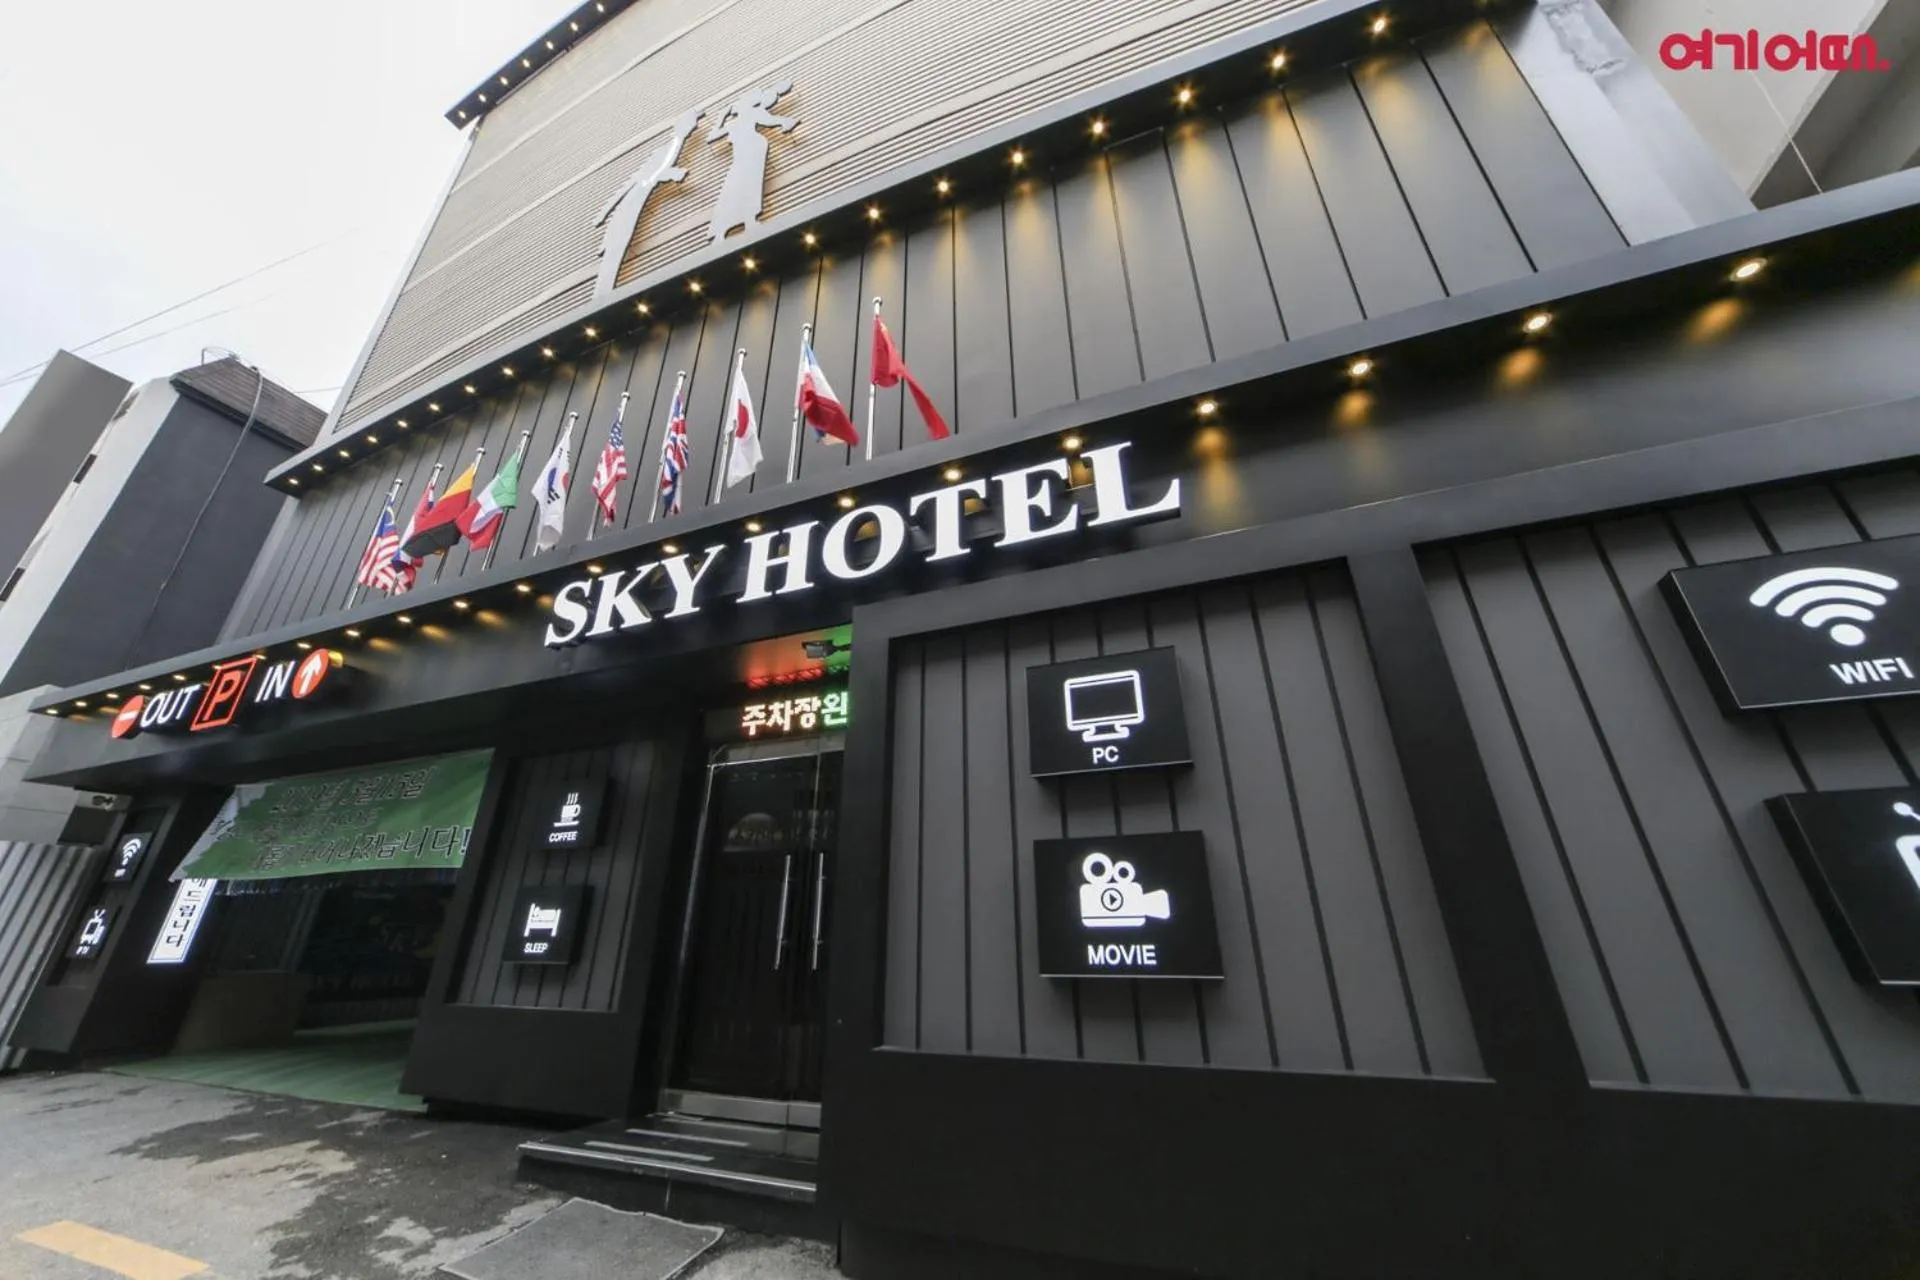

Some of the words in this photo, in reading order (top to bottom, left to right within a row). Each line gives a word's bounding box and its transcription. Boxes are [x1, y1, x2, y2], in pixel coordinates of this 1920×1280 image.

[544, 544, 721, 647] SKY
[737, 441, 1181, 603] HOTEL
[1829, 657, 1914, 685] WIFI
[140, 684, 202, 729] OUT
[203, 670, 242, 722] P
[255, 660, 297, 703] IN
[1092, 745, 1120, 764] PC
[548, 831, 579, 843] COFFEE
[523, 942, 549, 954] SLEEP
[1087, 944, 1158, 966] MOVIE
